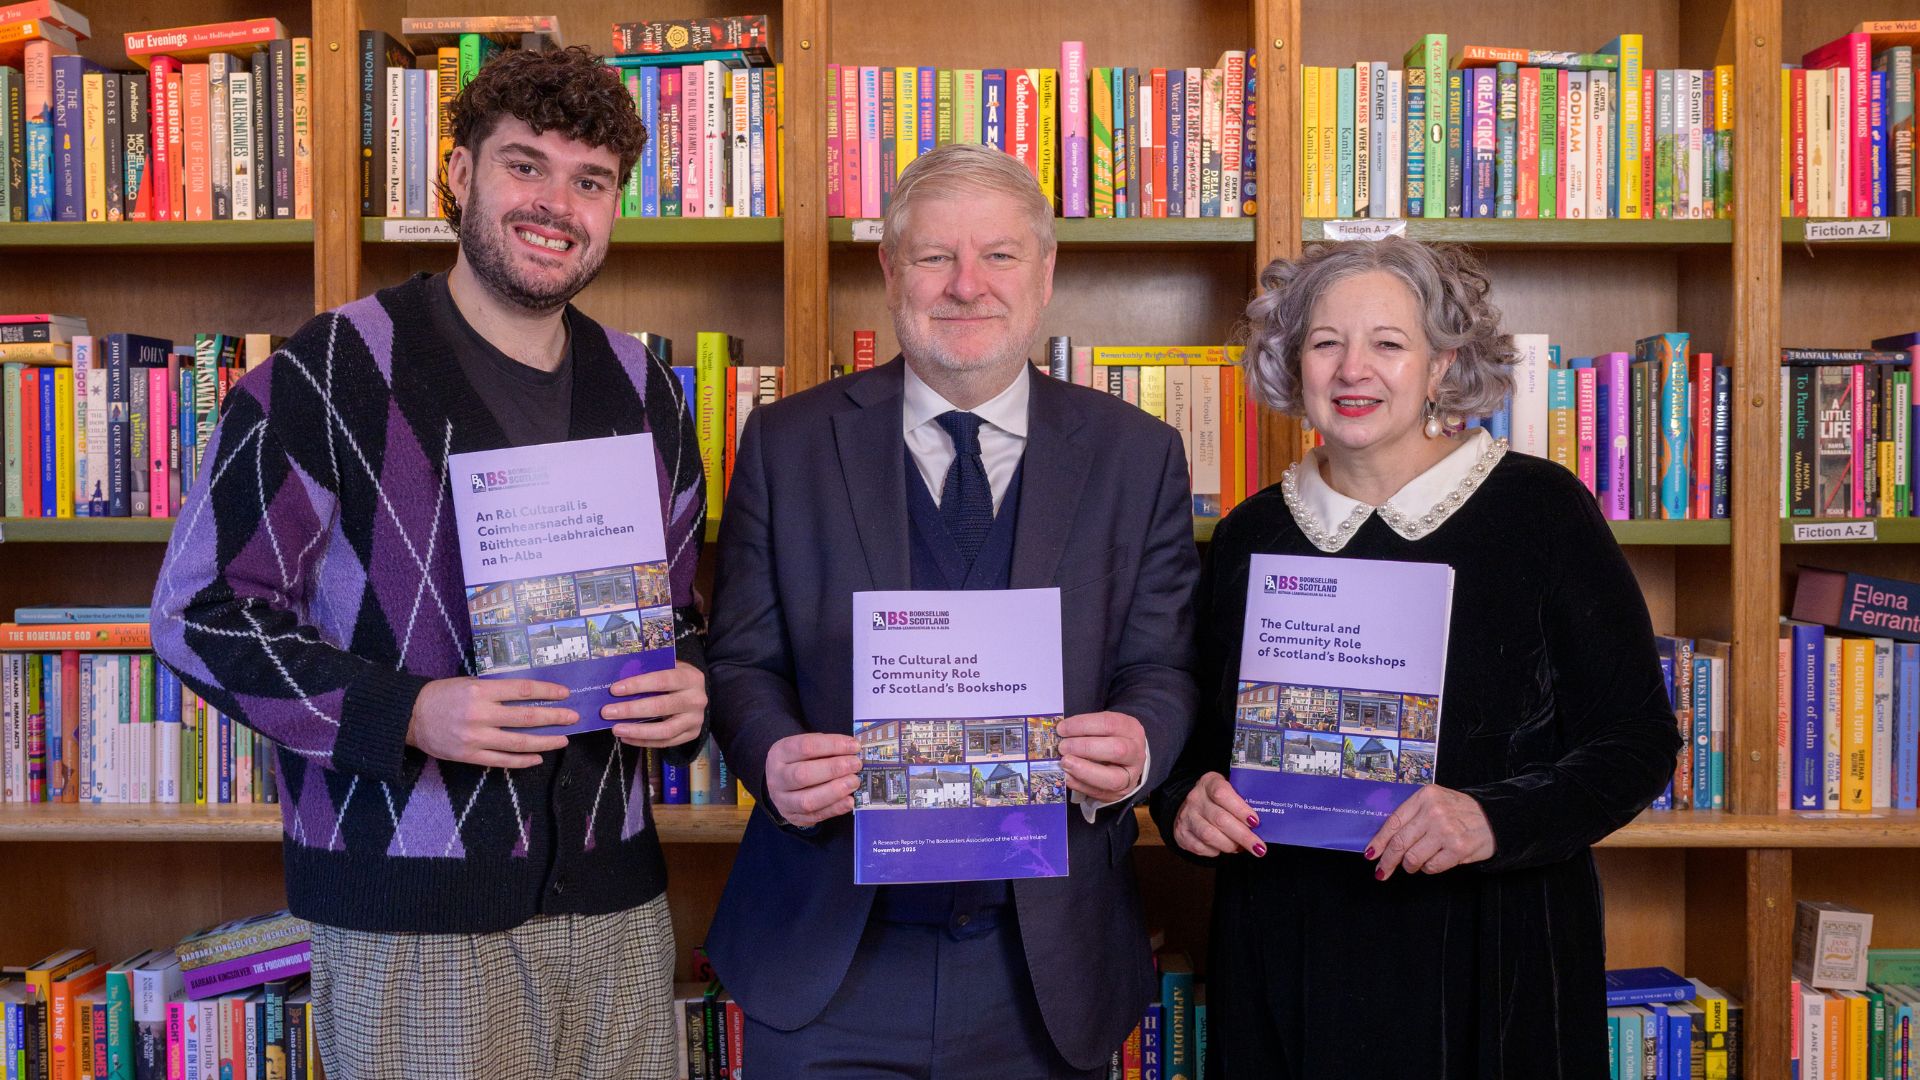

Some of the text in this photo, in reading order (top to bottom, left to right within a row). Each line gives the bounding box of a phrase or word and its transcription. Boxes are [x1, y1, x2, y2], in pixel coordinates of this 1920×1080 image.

[128, 32, 188, 49] Our Evenings
[654, 24, 662, 52] Mantel
[692, 26, 700, 46] Wolf
[1469, 49, 1523, 60] Ali Smith
[364, 51, 374, 91] WOMEN
[1069, 51, 1079, 113] thirst trap
[1692, 75, 1700, 90] Ali
[1896, 50, 1912, 103] BEARTOOTH
[56, 69, 66, 128] ELOPEMENT
[68, 89, 77, 109] THE
[106, 79, 116, 125] GORSE
[130, 82, 138, 122] Annihilation
[1376, 69, 1384, 121] CLEANER
[1501, 83, 1516, 119] SALKA
[1856, 42, 1867, 138] THESE MORTAL BODIES
[156, 93, 164, 123] EARTH
[168, 82, 179, 143] SUNBURN
[232, 79, 248, 157] THE ALTERNATIVES
[1016, 75, 1029, 141] Caledonian
[1224, 57, 1243, 172] BORDERLINE FICTION
[1478, 76, 1493, 160] GREAT CIRCLE
[1570, 82, 1581, 152] RODHAM
[1691, 91, 1700, 124] Smith
[157, 126, 165, 150] UPON
[363, 103, 372, 145] ARTEMIS
[1043, 114, 1051, 147] Andrew
[136, 134, 144, 167] MICHEL
[158, 153, 165, 162] IT
[1042, 148, 1050, 184] O'Hagan
[1896, 130, 1911, 192] CALLAN WINK
[127, 134, 136, 200] HOUELLEBECQ
[1503, 136, 1513, 205] FRANCESCA SIMON
[399, 226, 450, 234] Fiction A-Z
[1374, 226, 1391, 234] A-Z
[1811, 225, 1880, 236] Fiction A-Z
[139, 346, 164, 362] JOHN
[75, 344, 87, 454] Kakigori Summer
[112, 368, 120, 400] IRVING
[1797, 374, 1808, 439] To Paradise
[1821, 411, 1850, 421] LITTLE
[1832, 399, 1840, 409] A
[1582, 417, 1592, 441] GIRLS
[1822, 423, 1851, 438] LIFE
[113, 424, 122, 493] QUEEN ESTHER
[486, 470, 508, 486] BS
[476, 512, 493, 522] An
[496, 508, 517, 519] Ròl
[578, 500, 587, 510] is
[478, 513, 604, 537] Coimhearsnachd aig
[1798, 526, 1867, 538] Fiction A-Z
[482, 555, 496, 566] na
[1279, 576, 1298, 591] BS
[1299, 584, 1337, 592] SCOTLAND
[1853, 584, 1908, 610] Elena
[888, 612, 908, 626] BS
[1261, 618, 1360, 635] The Cultural and
[9, 631, 90, 641] THE HOMEMADE GOD
[1259, 633, 1362, 649] Community Role
[872, 655, 978, 665] The Cultural and
[1258, 648, 1406, 668] of Scotland's Bookshops
[872, 669, 980, 681] Community Role
[872, 682, 1027, 694] of Scotland's Bookshops
[1806, 643, 1817, 749] a moment of calm
[1855, 646, 1865, 744] THE CULTURAL TUTOR
[54, 996, 65, 1040] Lily King
[171, 1008, 179, 1042] BRIGHT
[94, 1010, 107, 1077] SHELL GAMES
[247, 1017, 255, 1068] EUROTRASH
